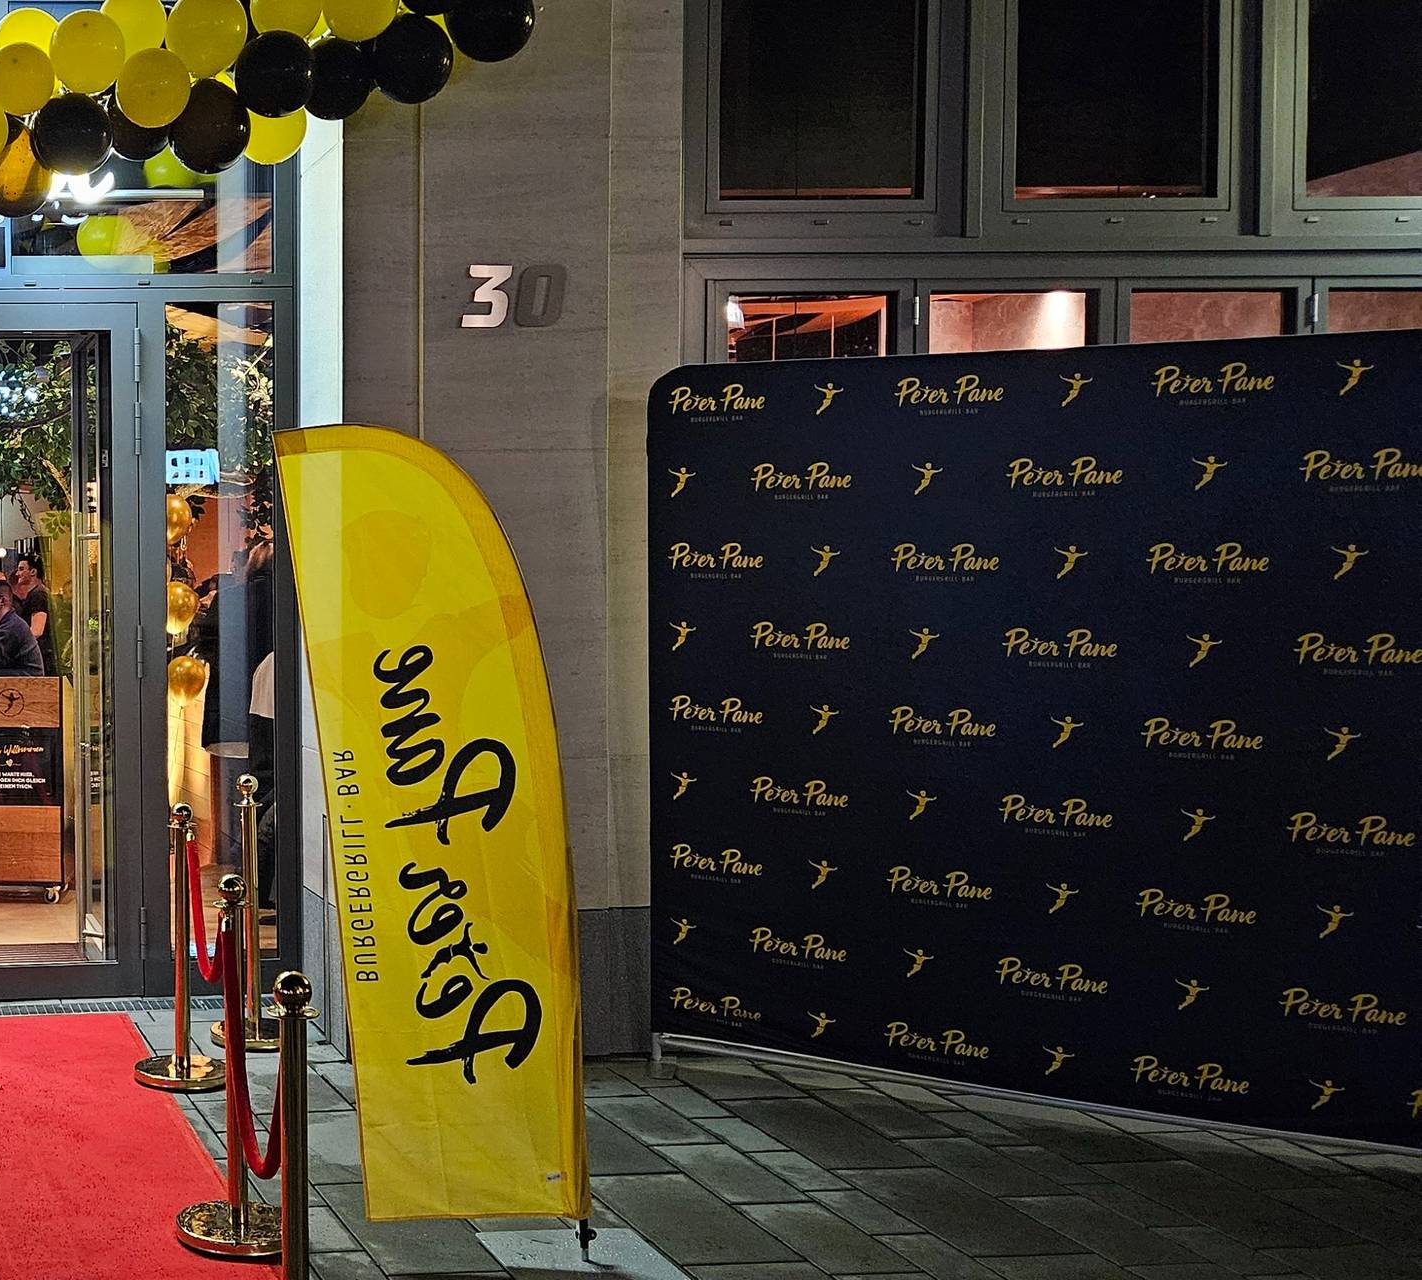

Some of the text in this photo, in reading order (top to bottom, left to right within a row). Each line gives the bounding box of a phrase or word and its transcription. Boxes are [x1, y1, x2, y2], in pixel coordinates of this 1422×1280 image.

[461, 264, 567, 328] 30
[894, 374, 1004, 408] Peter Pane
[1151, 362, 1275, 397] Peter Pane
[668, 383, 765, 415] Peter Pane
[750, 462, 852, 492] Peter Pane
[1005, 456, 1123, 489] Peter Pane
[1299, 447, 1422, 482] Peter Pan
[667, 542, 764, 570] Peter Pane
[890, 543, 999, 572] Peter Pane
[1145, 542, 1270, 574] Peter Pane
[749, 621, 851, 650] Peter Pane
[1002, 627, 1118, 658] Peter Pane
[1293, 632, 1422, 666] Peter Pane
[668, 695, 763, 724] Peter Pane
[888, 706, 996, 737] Peter Pane
[1140, 717, 1263, 750] Peter Pane
[749, 776, 848, 807] Peter Pane
[998, 794, 1113, 828] Peter Pane
[1286, 812, 1415, 847] Peter Pane
[669, 843, 763, 876] Peter Pane
[886, 865, 992, 900] Peter Pane
[1135, 888, 1256, 924] Peter Pane
[748, 927, 847, 962] Peter Pane
[995, 957, 1108, 994] Peter Pane
[719, 996, 761, 1021] Pane
[1278, 987, 1407, 1025] Peter Pane
[883, 1021, 936, 1051] Peter
[939, 1029, 989, 1059] Pane
[1130, 1055, 1249, 1095] Peter Pane
